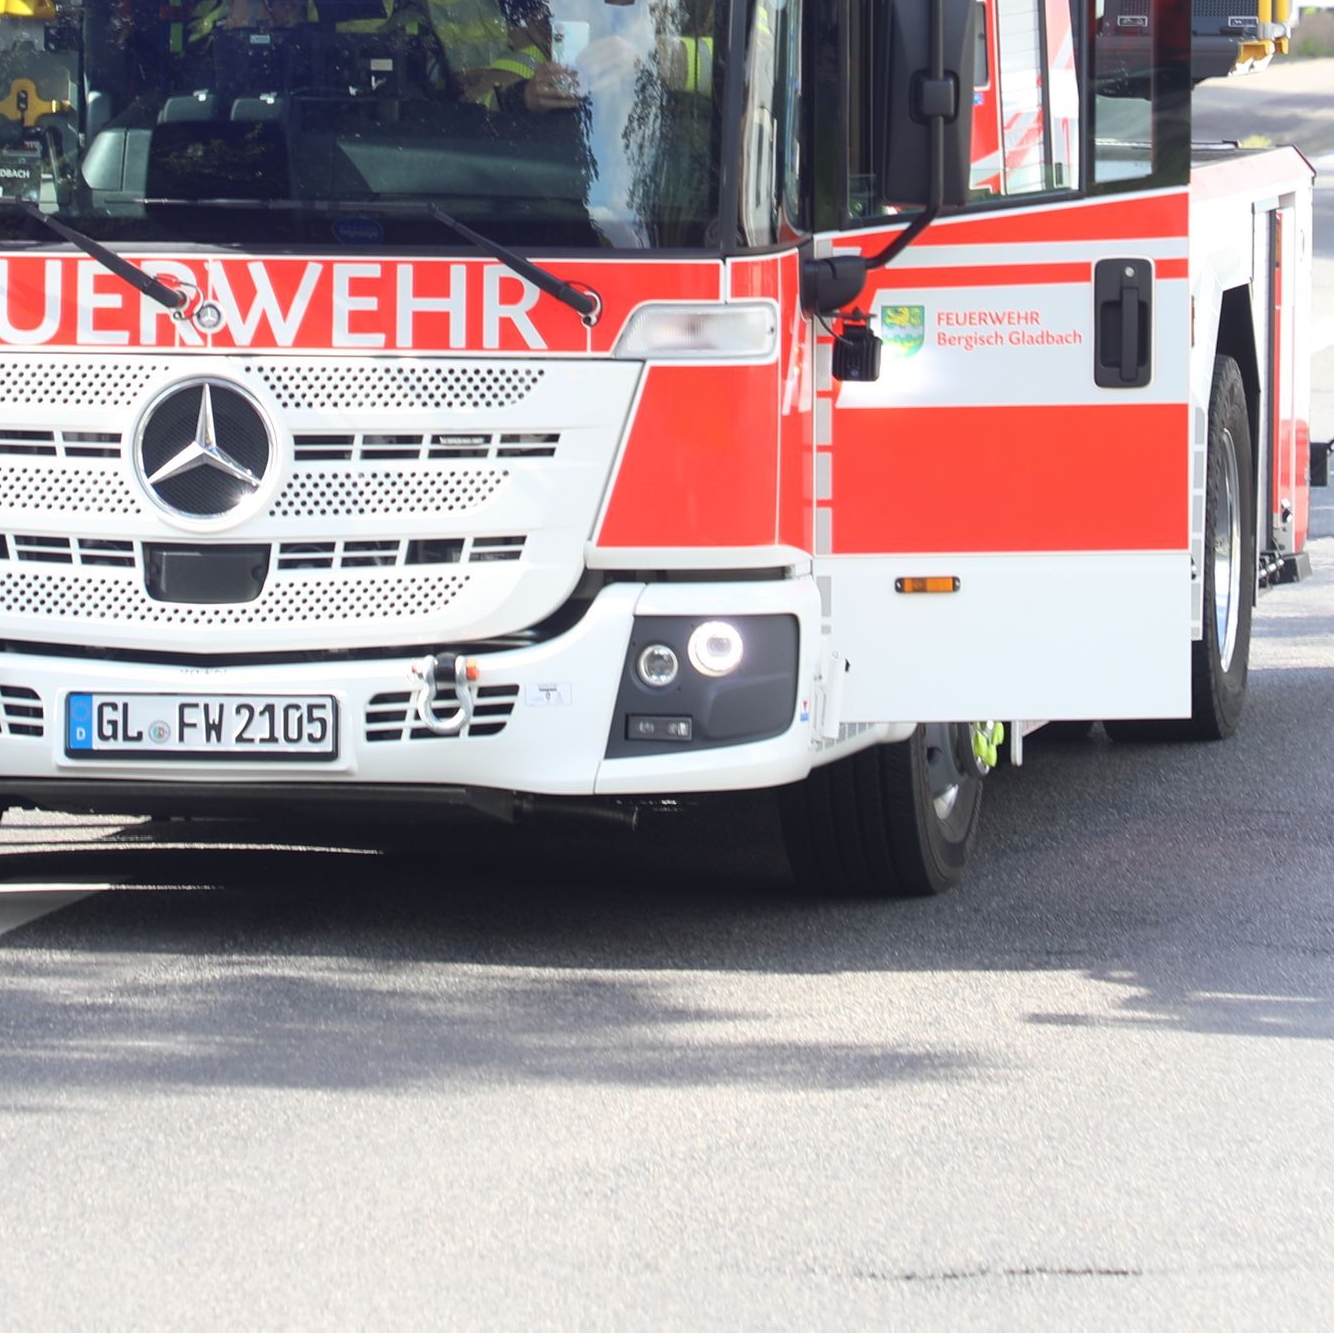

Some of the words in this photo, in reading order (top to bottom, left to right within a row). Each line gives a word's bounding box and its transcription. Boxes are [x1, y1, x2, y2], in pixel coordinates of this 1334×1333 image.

[937, 310, 1040, 326] FEUERWEHR
[937, 330, 1003, 350] Bergisch
[1009, 329, 1083, 345] Gladbach
[97, 702, 144, 742] GL
[178, 703, 224, 743] FW
[235, 704, 329, 744] 2105
[76, 727, 86, 741] D
